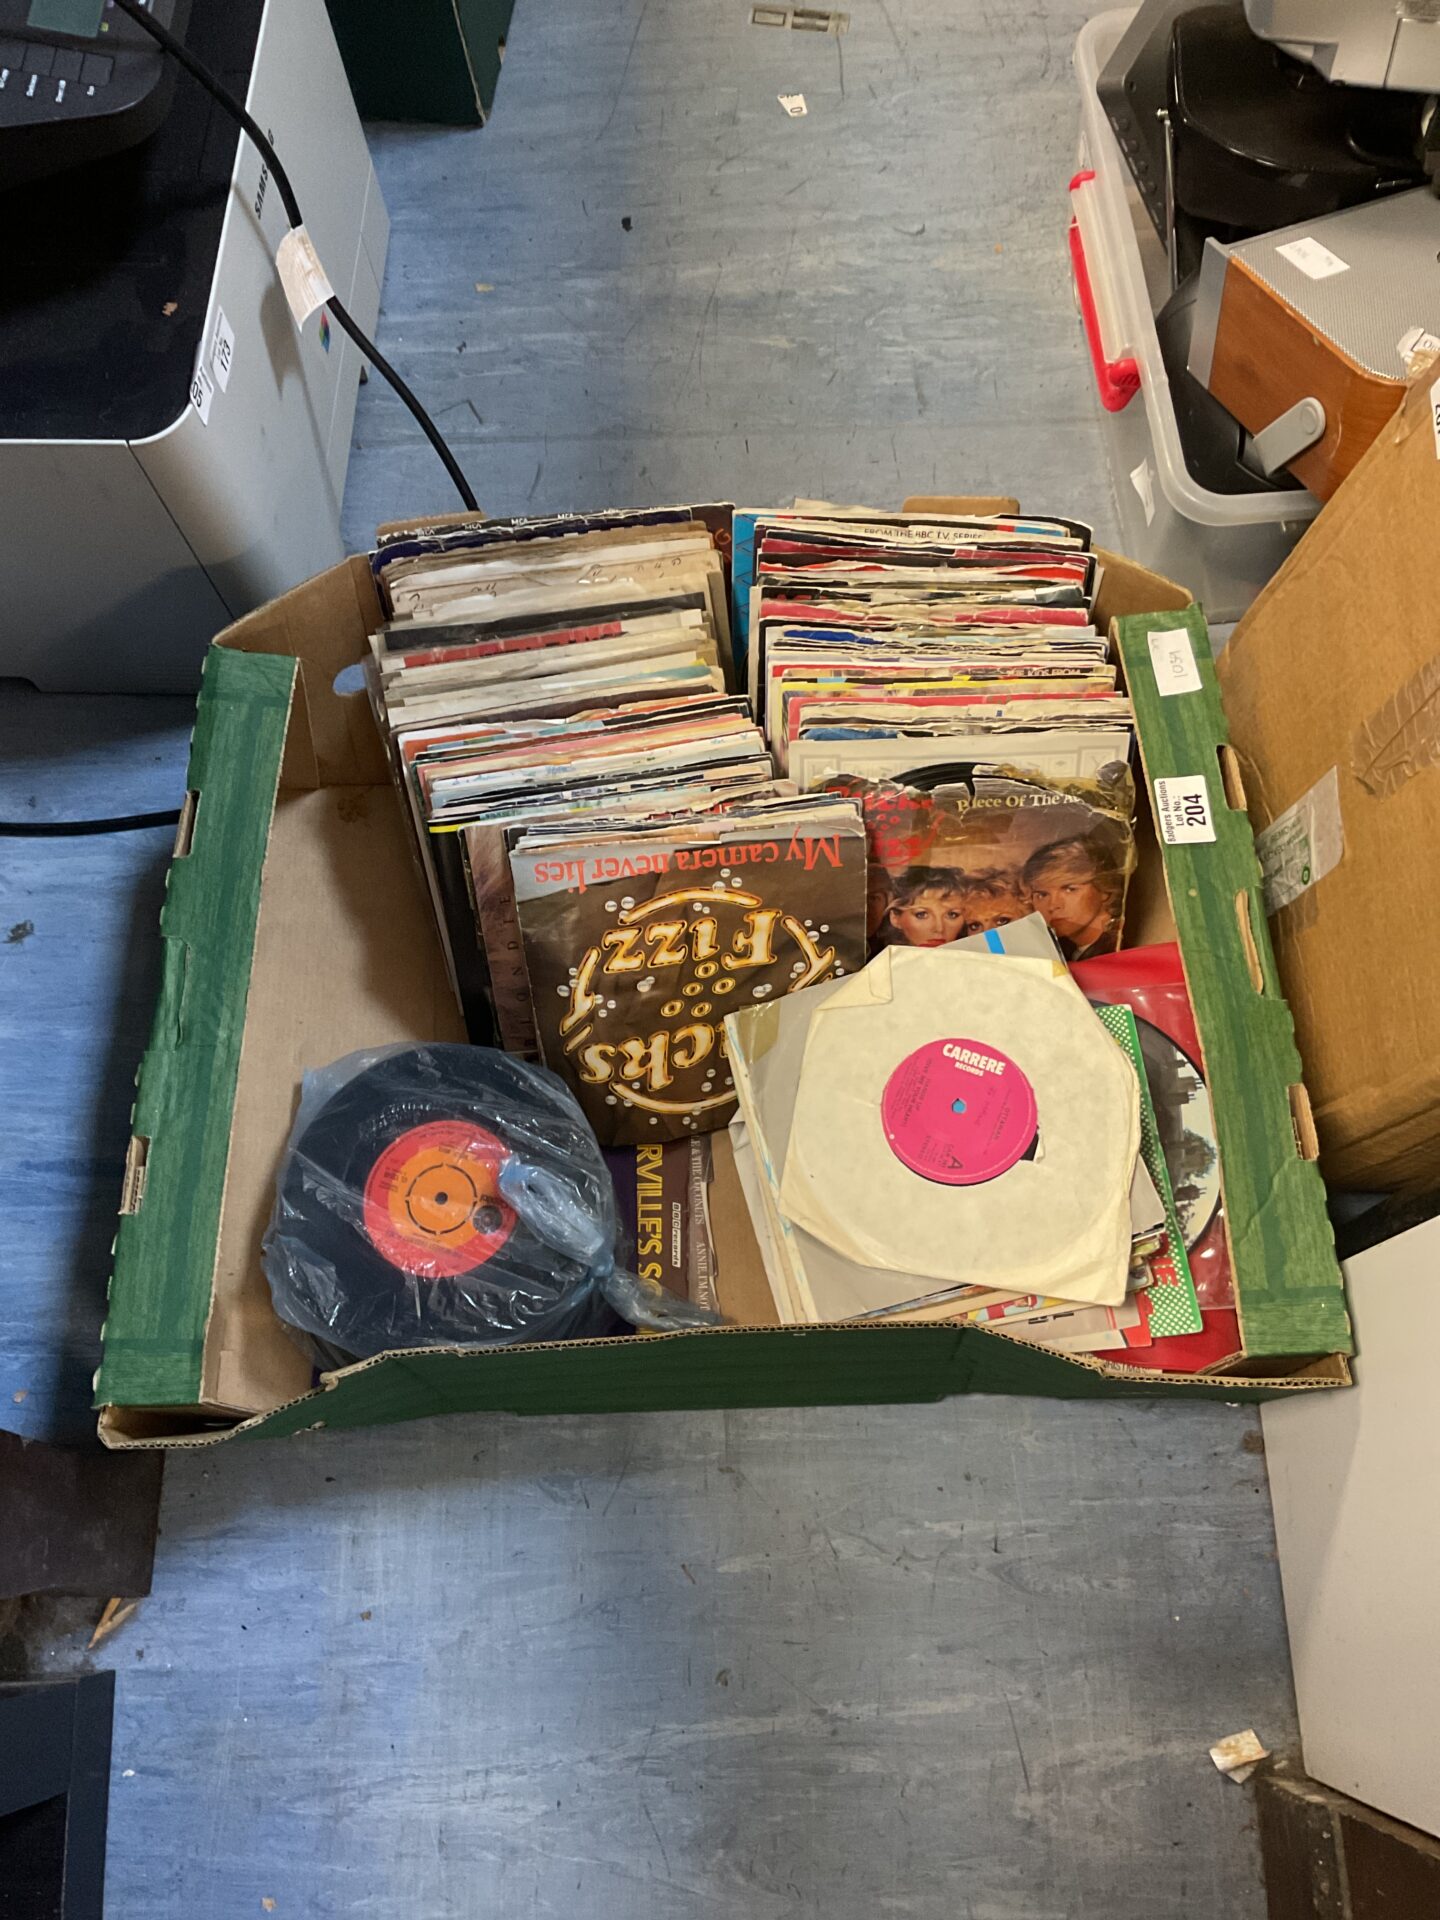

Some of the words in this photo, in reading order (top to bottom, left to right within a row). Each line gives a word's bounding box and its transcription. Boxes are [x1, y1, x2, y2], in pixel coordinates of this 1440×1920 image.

[255, 128, 274, 219] SAMSG
[220, 339, 231, 373] 173
[511, 518, 531, 526] MCA
[896, 529, 914, 538] THE
[915, 530, 934, 539] BBC
[1006, 795, 1027, 807] Of
[1029, 794, 1060, 807] The
[1158, 780, 1171, 812] Auctions
[1182, 793, 1207, 827] 204
[1164, 814, 1177, 842] Badgers
[1175, 814, 1185, 827] Lot
[674, 841, 780, 870] camera
[785, 828, 844, 871] My
[534, 859, 588, 895] lies
[592, 854, 670, 880] never
[602, 909, 783, 974] Fizz
[942, 1043, 1006, 1076] CARRERE
[954, 1061, 984, 1077] RECORDS
[948, 1156, 963, 1169] A
[671, 1202, 682, 1229] BBC
[671, 1229, 682, 1267] records
